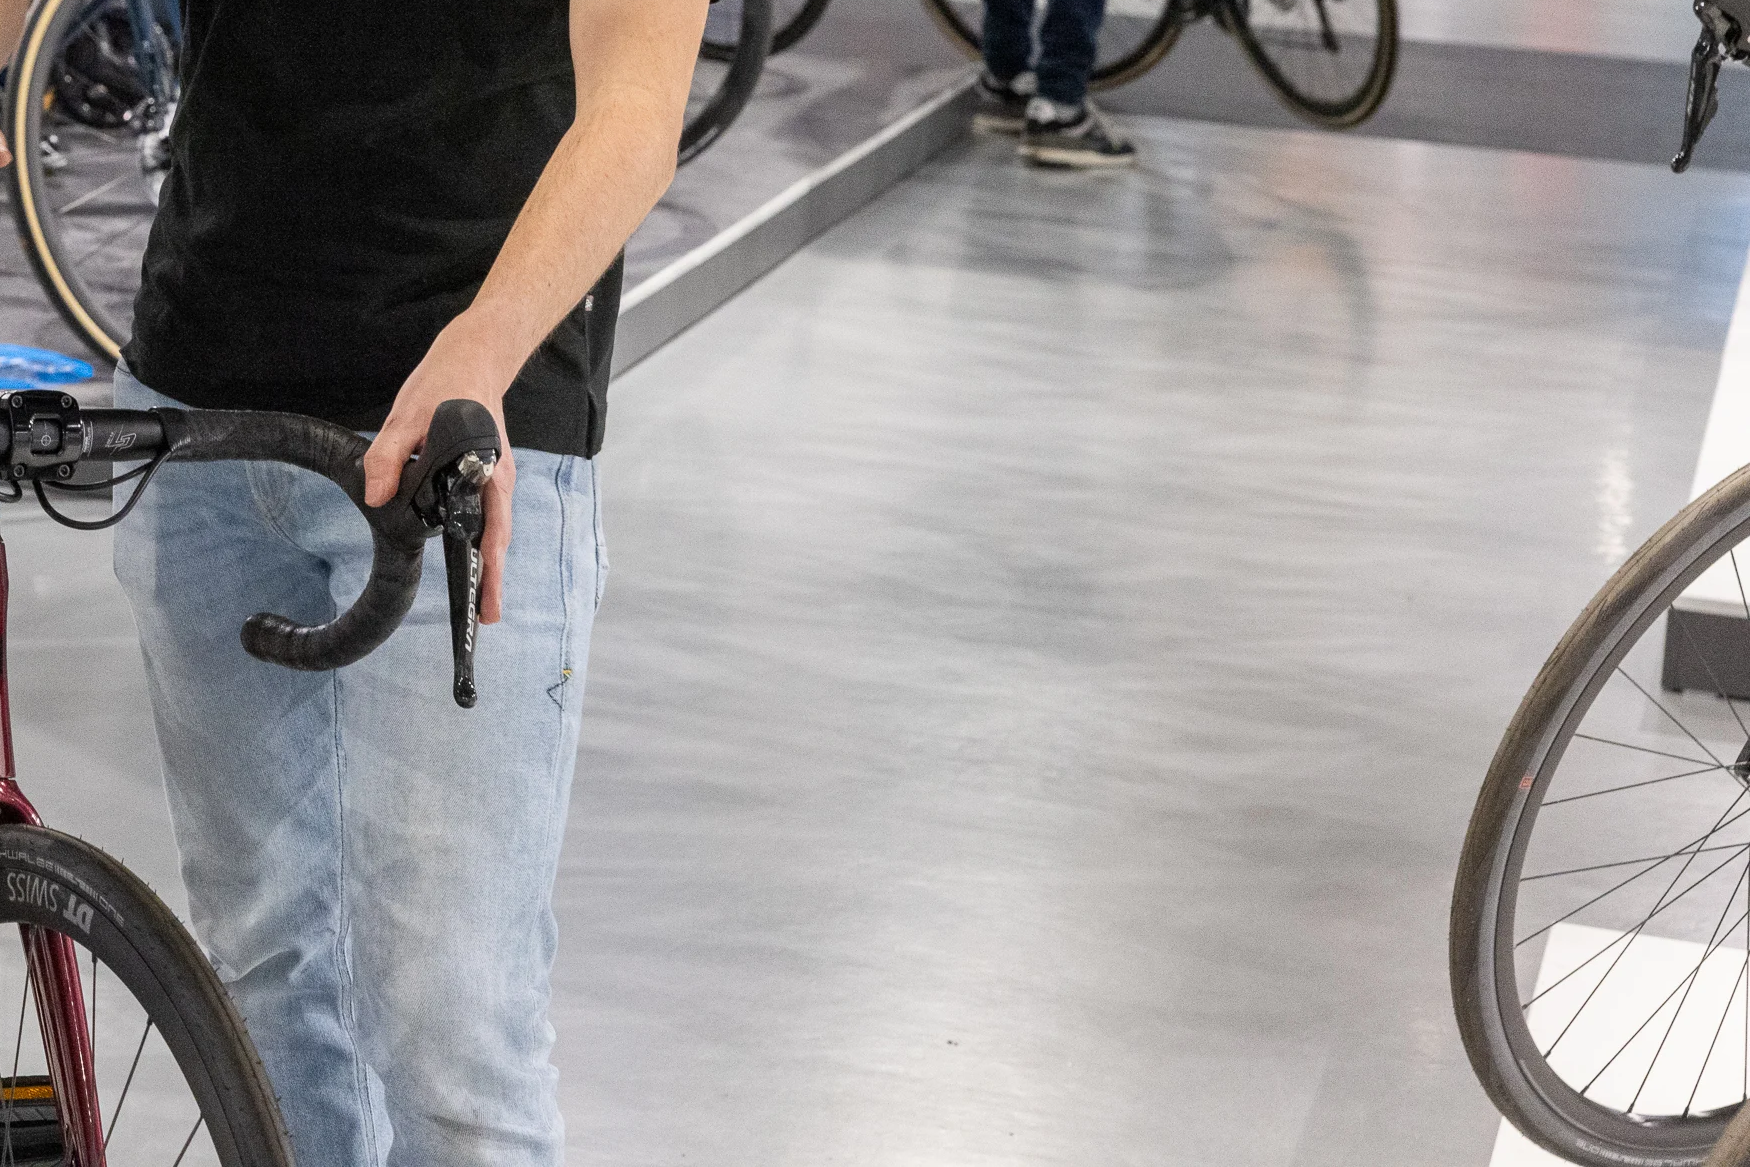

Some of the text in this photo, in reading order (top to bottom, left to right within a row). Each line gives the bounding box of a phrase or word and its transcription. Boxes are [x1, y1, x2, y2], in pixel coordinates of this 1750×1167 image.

[464, 547, 478, 653] ULTEGRA
[7, 872, 60, 913] SWISS
[62, 893, 94, 934] DT
